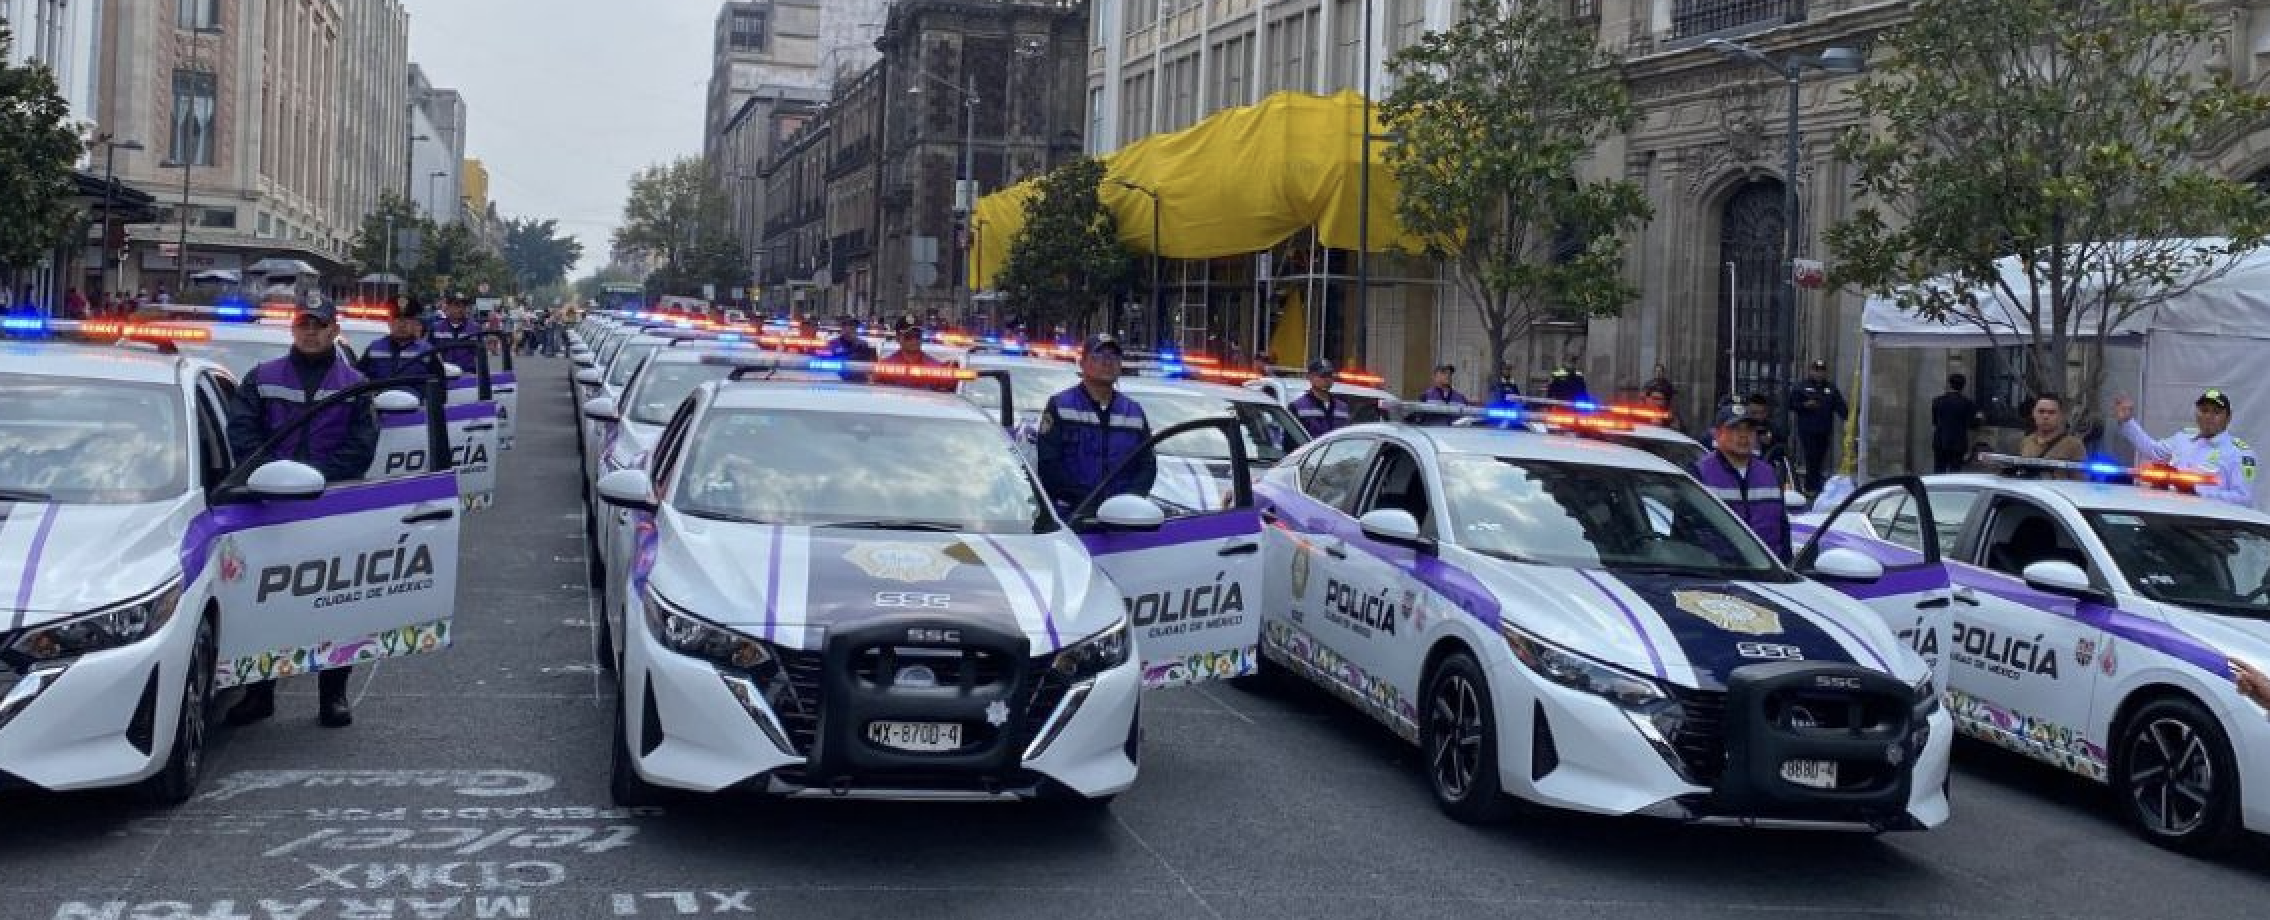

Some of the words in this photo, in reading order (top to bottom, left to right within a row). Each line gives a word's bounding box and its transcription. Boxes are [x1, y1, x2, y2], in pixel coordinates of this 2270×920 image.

[386, 436, 488, 474] POCÍA
[256, 533, 434, 602] POLICÍA
[313, 591, 362, 609] CIUDAD
[366, 587, 384, 599] DE
[876, 591, 951, 609] SSC
[1326, 578, 1396, 637] POLICÍA
[907, 628, 961, 643] SSC
[1147, 622, 1187, 639] CIUDAD
[1736, 642, 1805, 661] SSC
[1815, 675, 1861, 689] SSC
[304, 806, 408, 820] POR
[261, 825, 641, 857] telcel
[296, 859, 567, 890] CDMX
[612, 888, 754, 914] XLI
